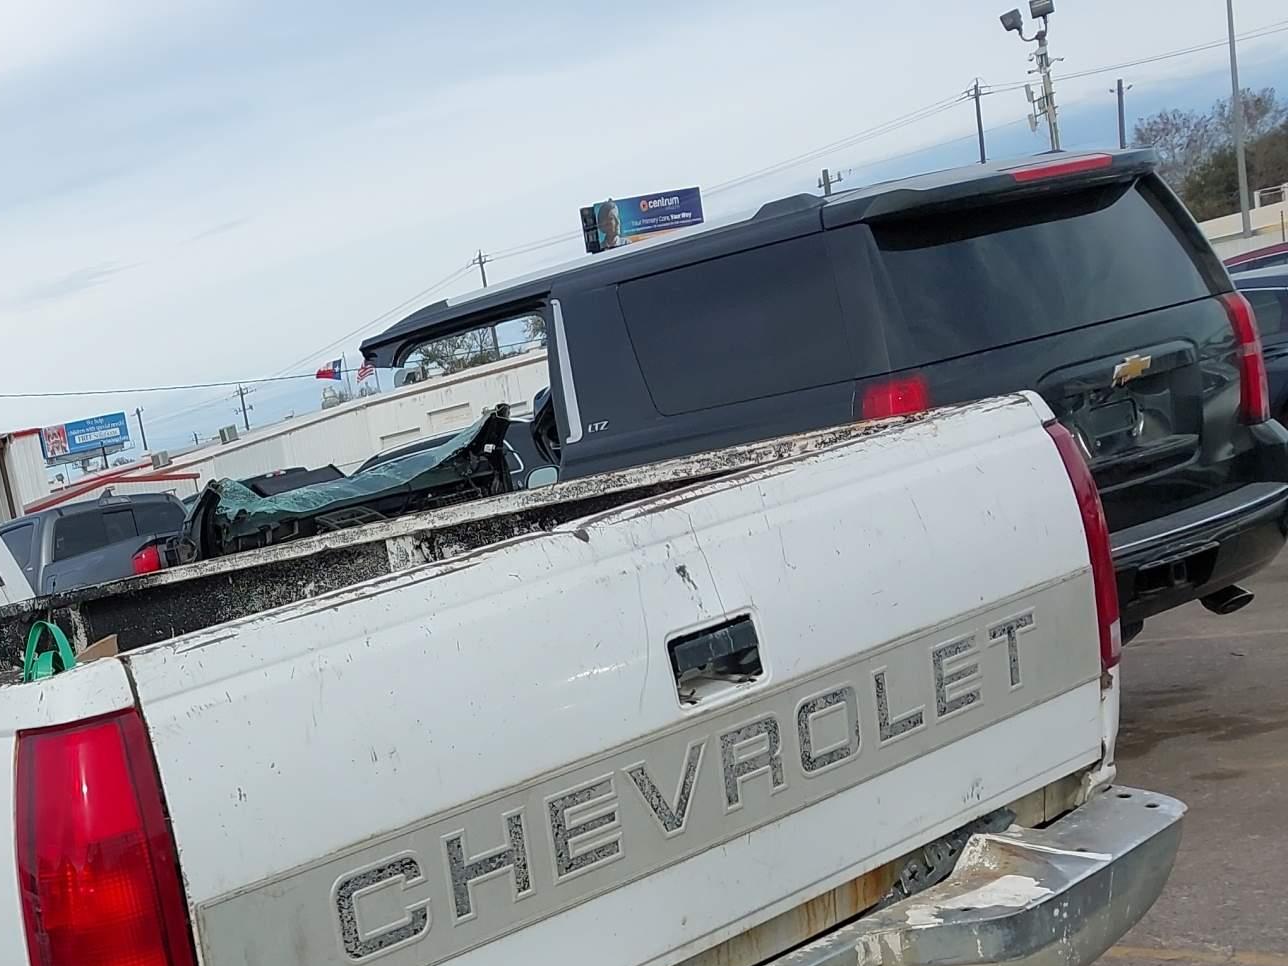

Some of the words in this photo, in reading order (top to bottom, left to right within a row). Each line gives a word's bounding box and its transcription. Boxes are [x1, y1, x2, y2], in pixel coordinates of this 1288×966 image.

[648, 196, 680, 209] centrum
[588, 420, 609, 433] LTZ
[331, 608, 1036, 964] CHEVROLET
